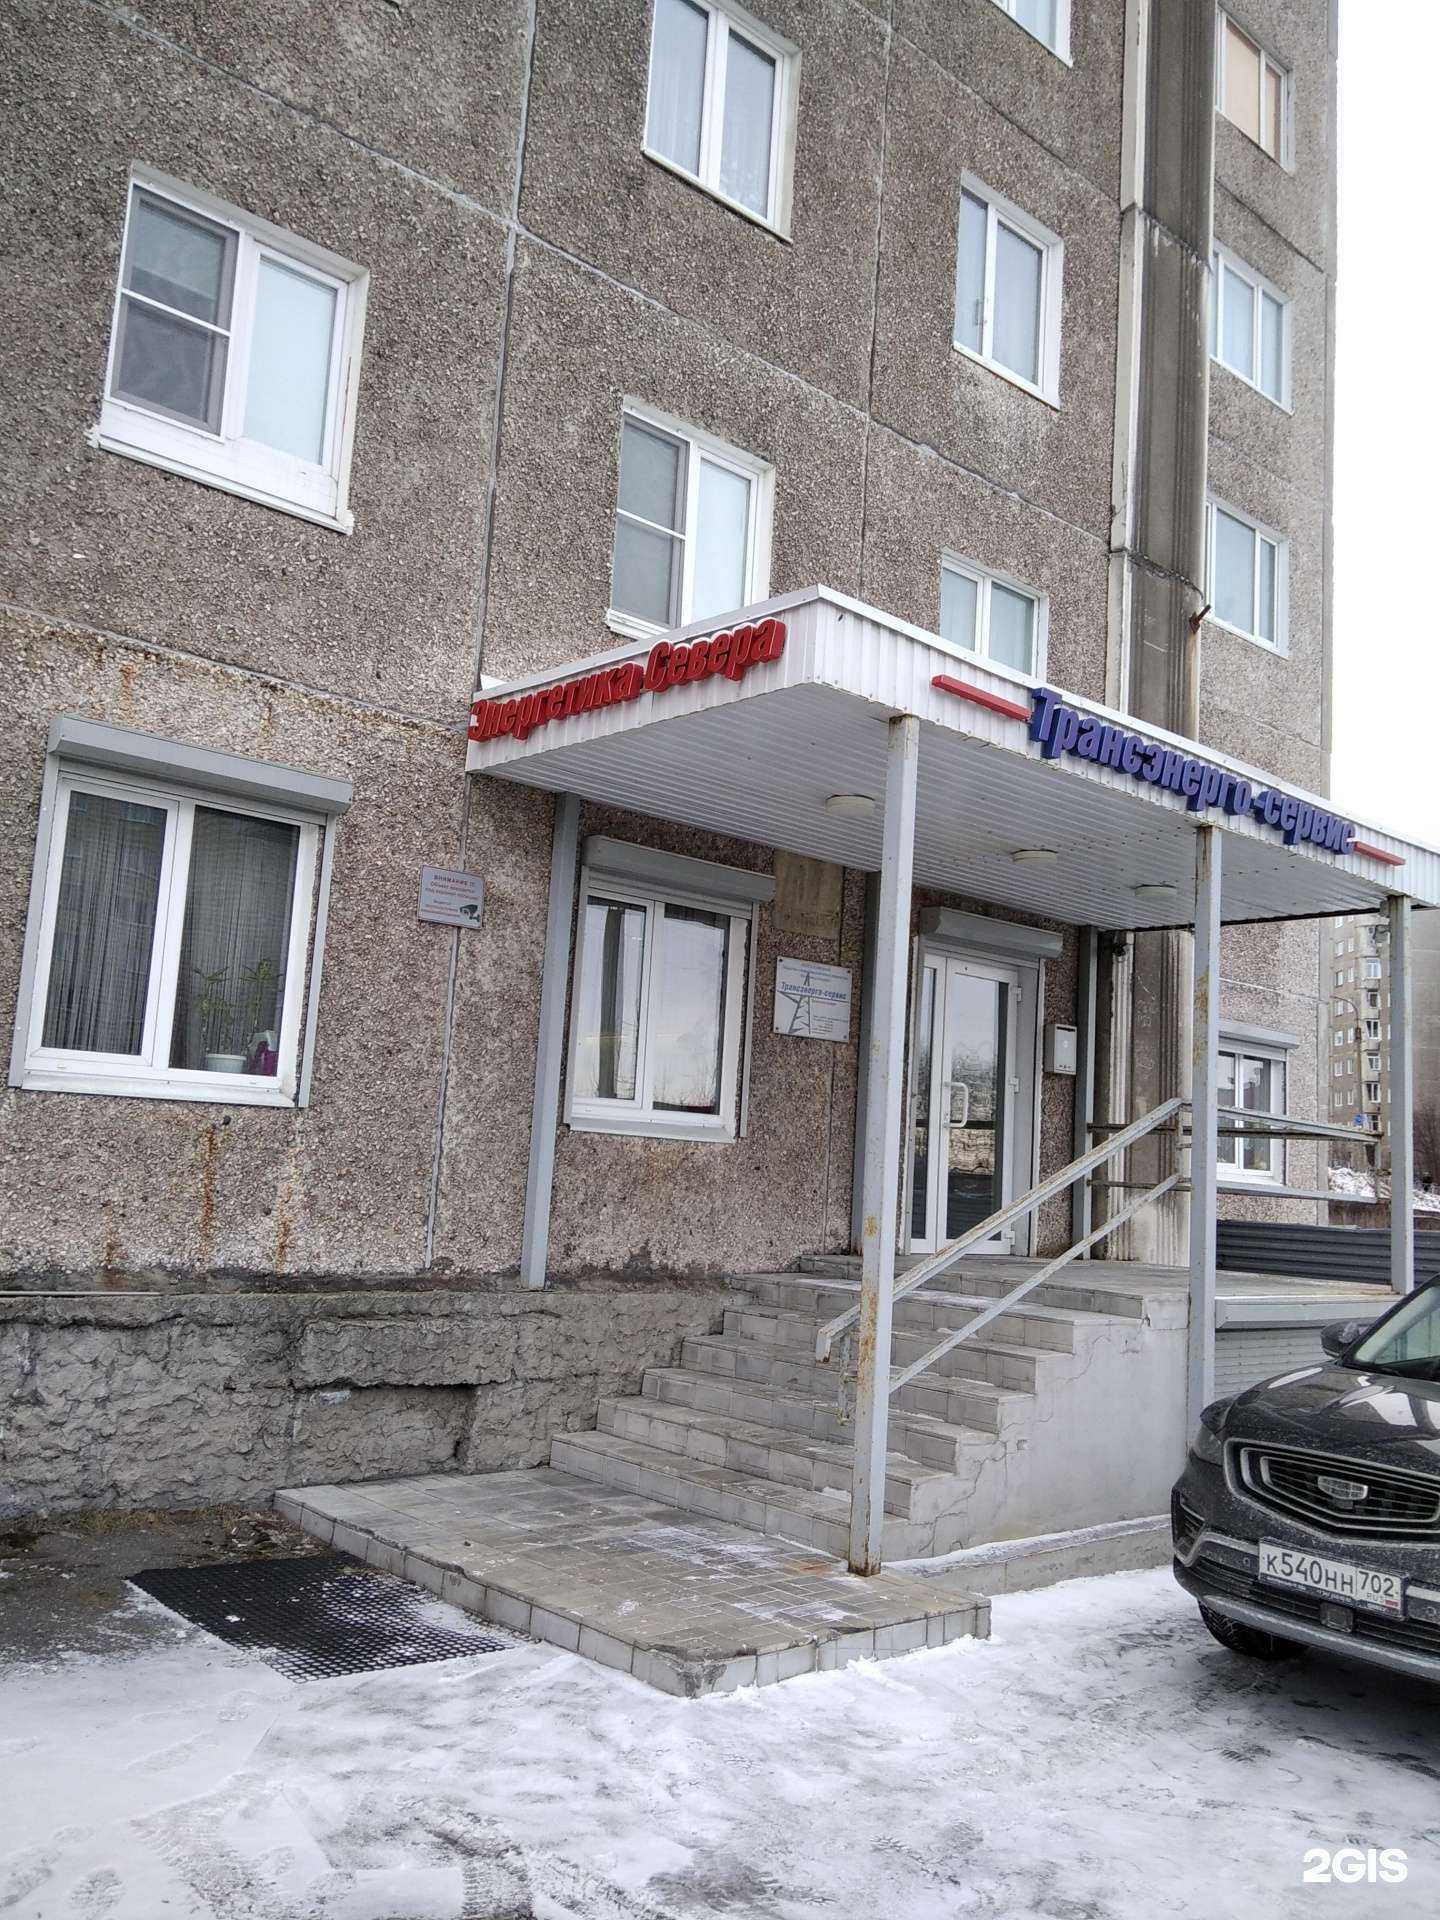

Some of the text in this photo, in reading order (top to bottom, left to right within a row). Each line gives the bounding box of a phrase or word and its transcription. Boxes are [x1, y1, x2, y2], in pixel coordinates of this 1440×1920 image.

[467, 616, 787, 742] Энергетика Севера
[781, 981, 847, 1000] Трансэнерго-сервис
